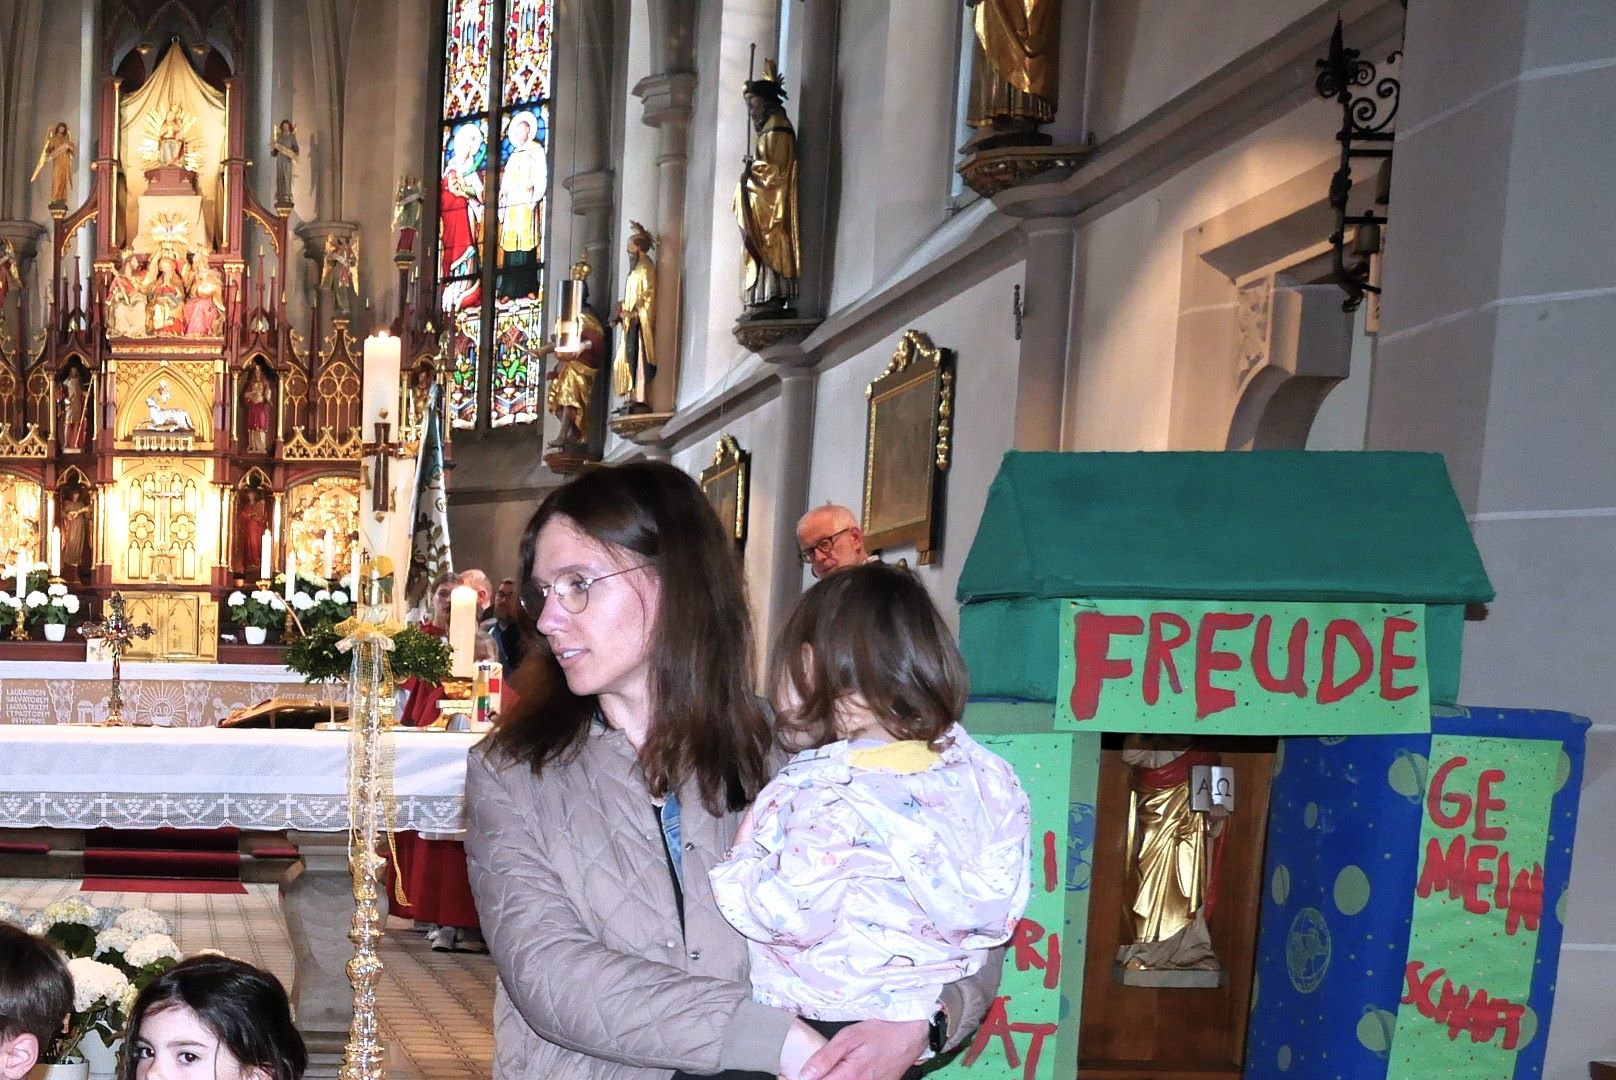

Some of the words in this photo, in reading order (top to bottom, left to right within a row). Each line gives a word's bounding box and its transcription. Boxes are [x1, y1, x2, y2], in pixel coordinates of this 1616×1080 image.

[1070, 609, 1419, 721] FREUDE
[1427, 756, 1507, 840] GE
[1416, 824, 1544, 936] MEIN
